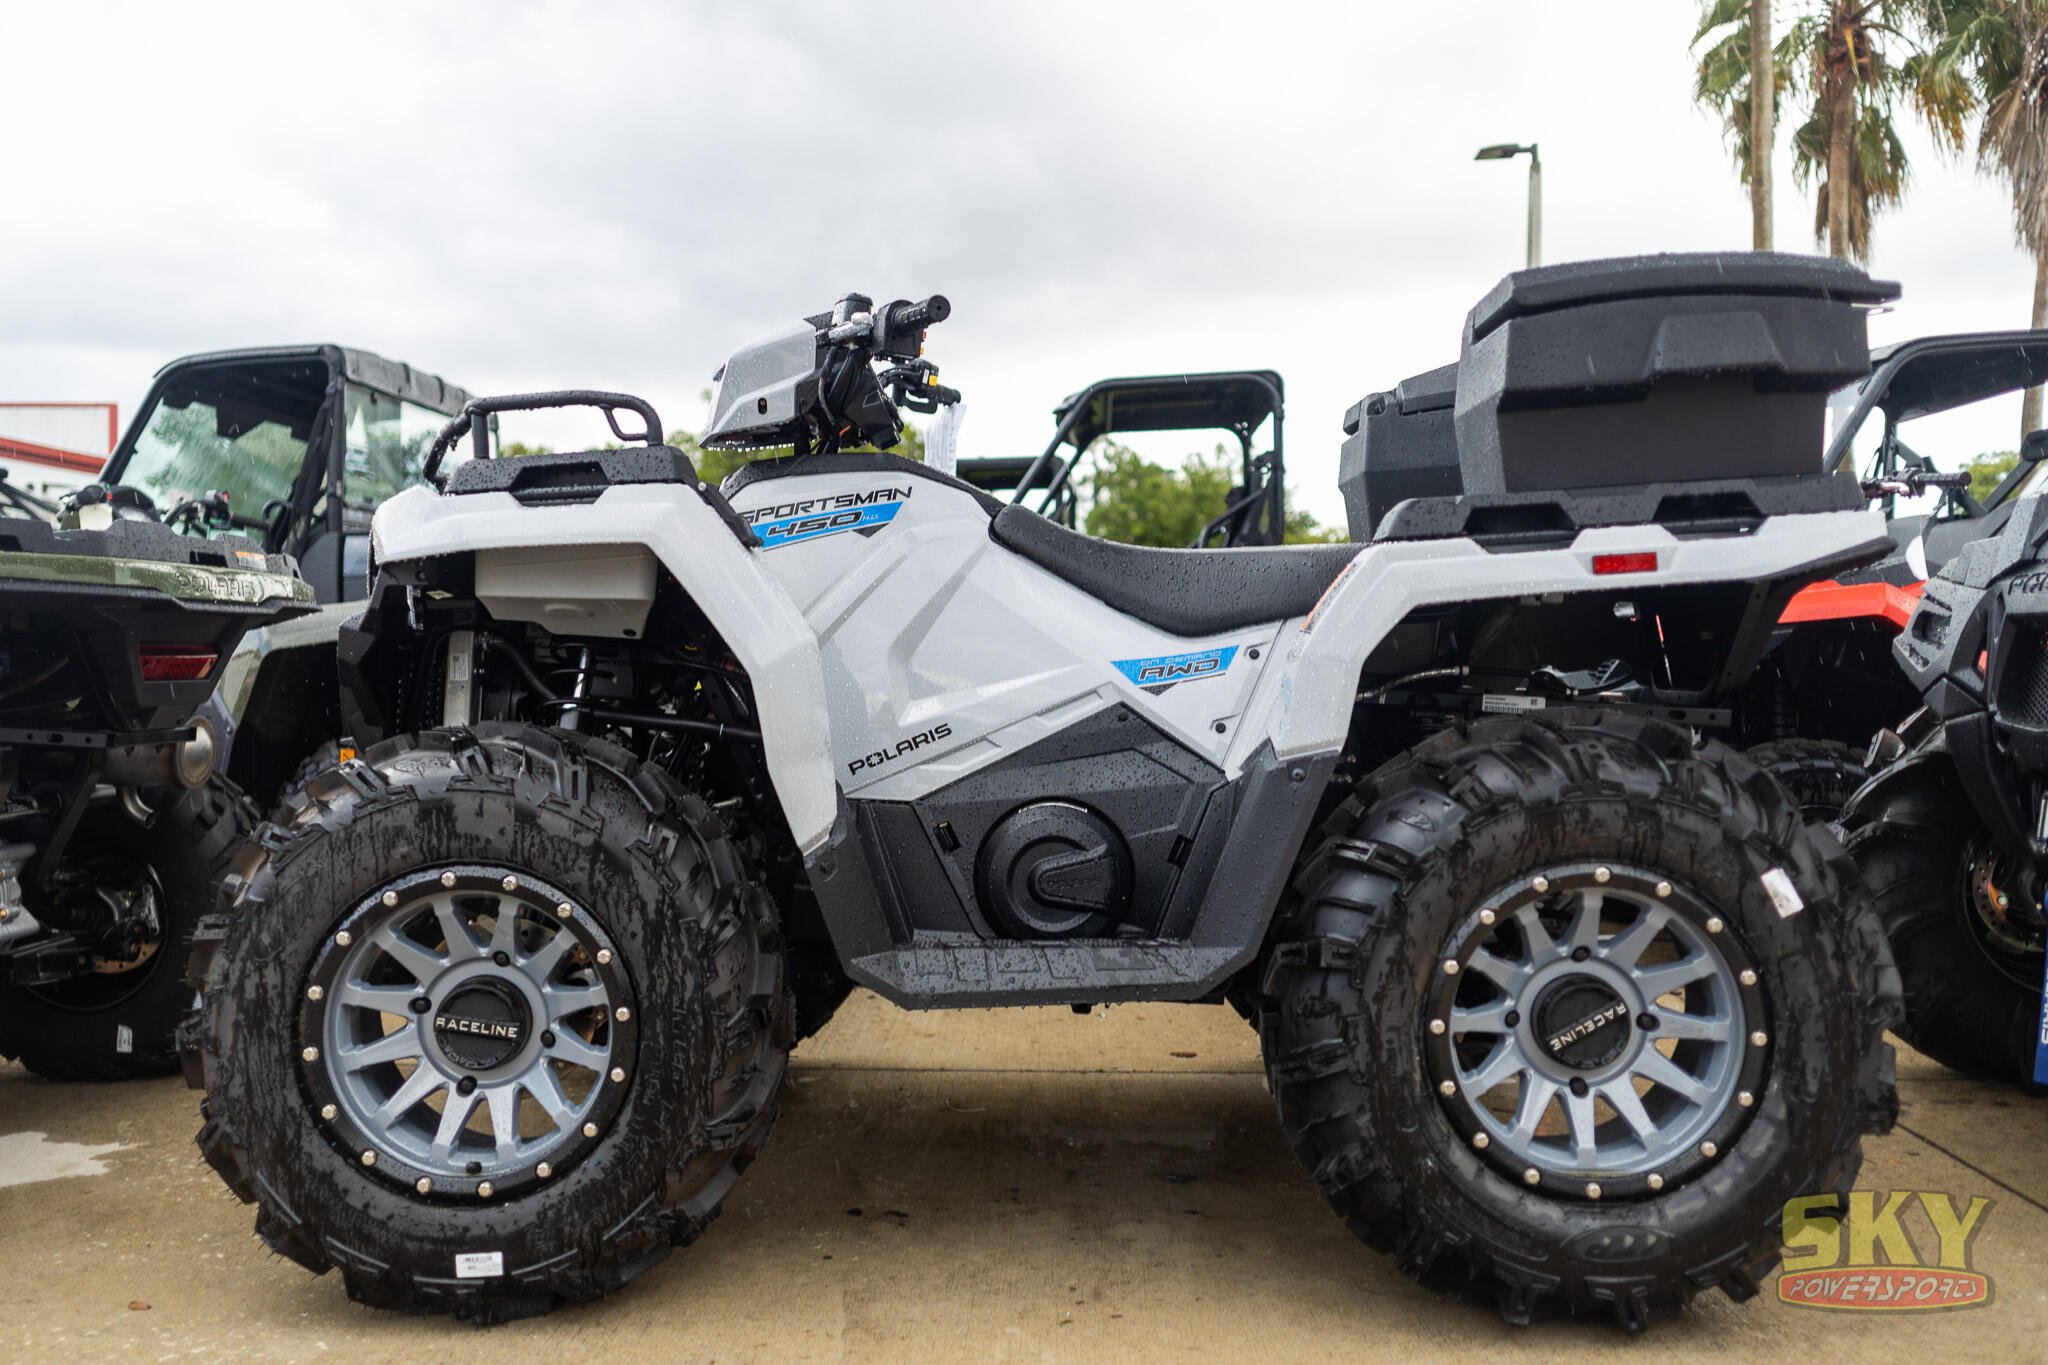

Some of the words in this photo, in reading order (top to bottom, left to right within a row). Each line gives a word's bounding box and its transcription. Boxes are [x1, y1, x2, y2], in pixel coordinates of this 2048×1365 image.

[738, 486, 913, 523] SPORTSMAN
[767, 510, 863, 538] 450
[1138, 658, 1220, 681] AWD
[1165, 650, 1222, 665] DEMAND
[848, 723, 952, 776] POLARIS
[435, 1017, 518, 1038] RACELINE
[1549, 1002, 1627, 1052] RACELINE
